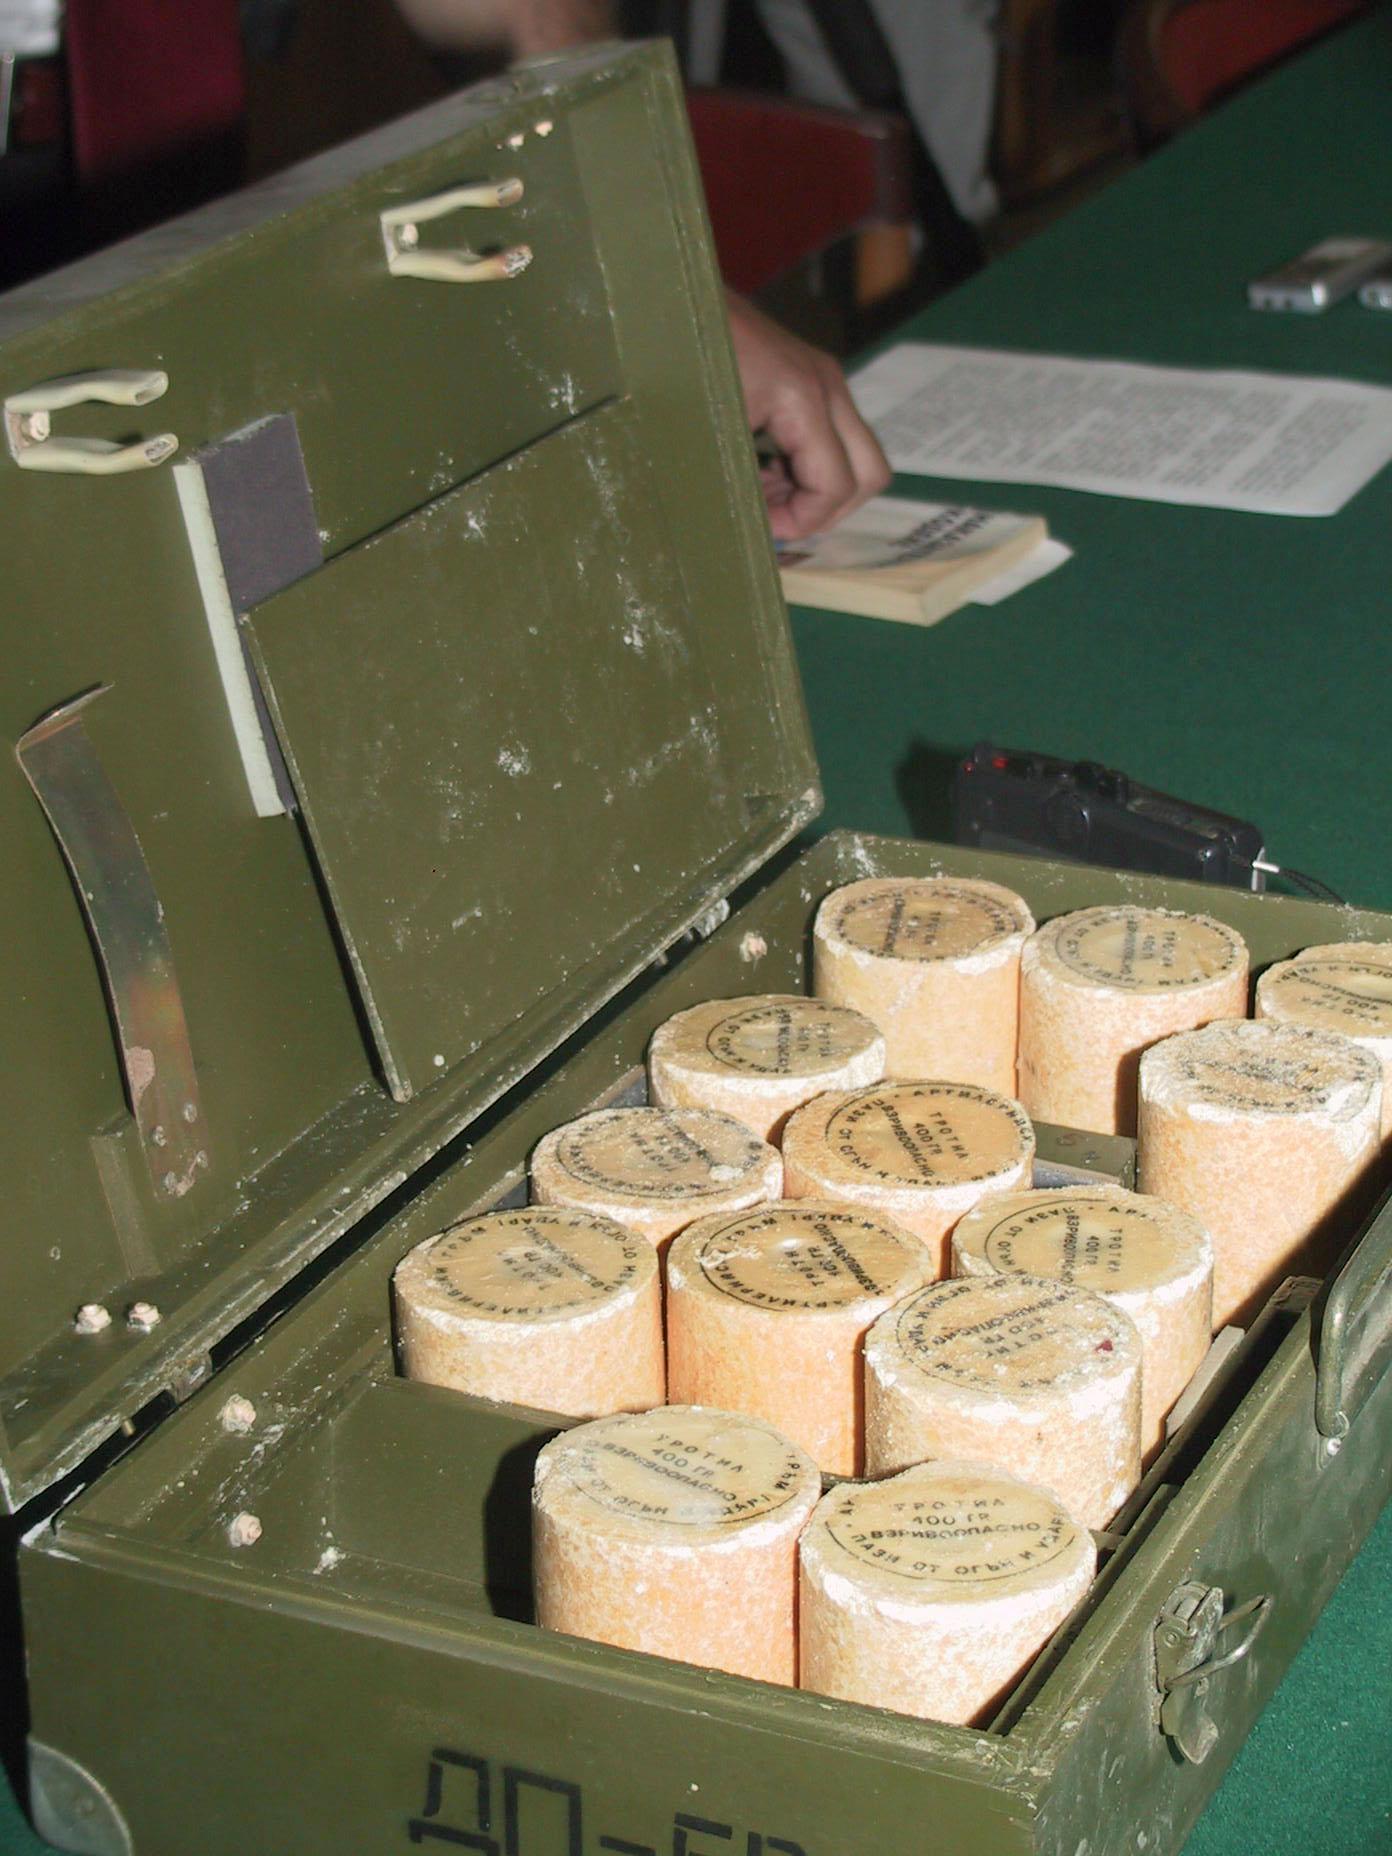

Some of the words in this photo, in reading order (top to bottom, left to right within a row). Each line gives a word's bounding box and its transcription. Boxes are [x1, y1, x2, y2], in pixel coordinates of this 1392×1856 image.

[913, 1122, 934, 1143] 400
[651, 1448, 689, 1469] 400
[912, 1561, 939, 1574] ОТ
